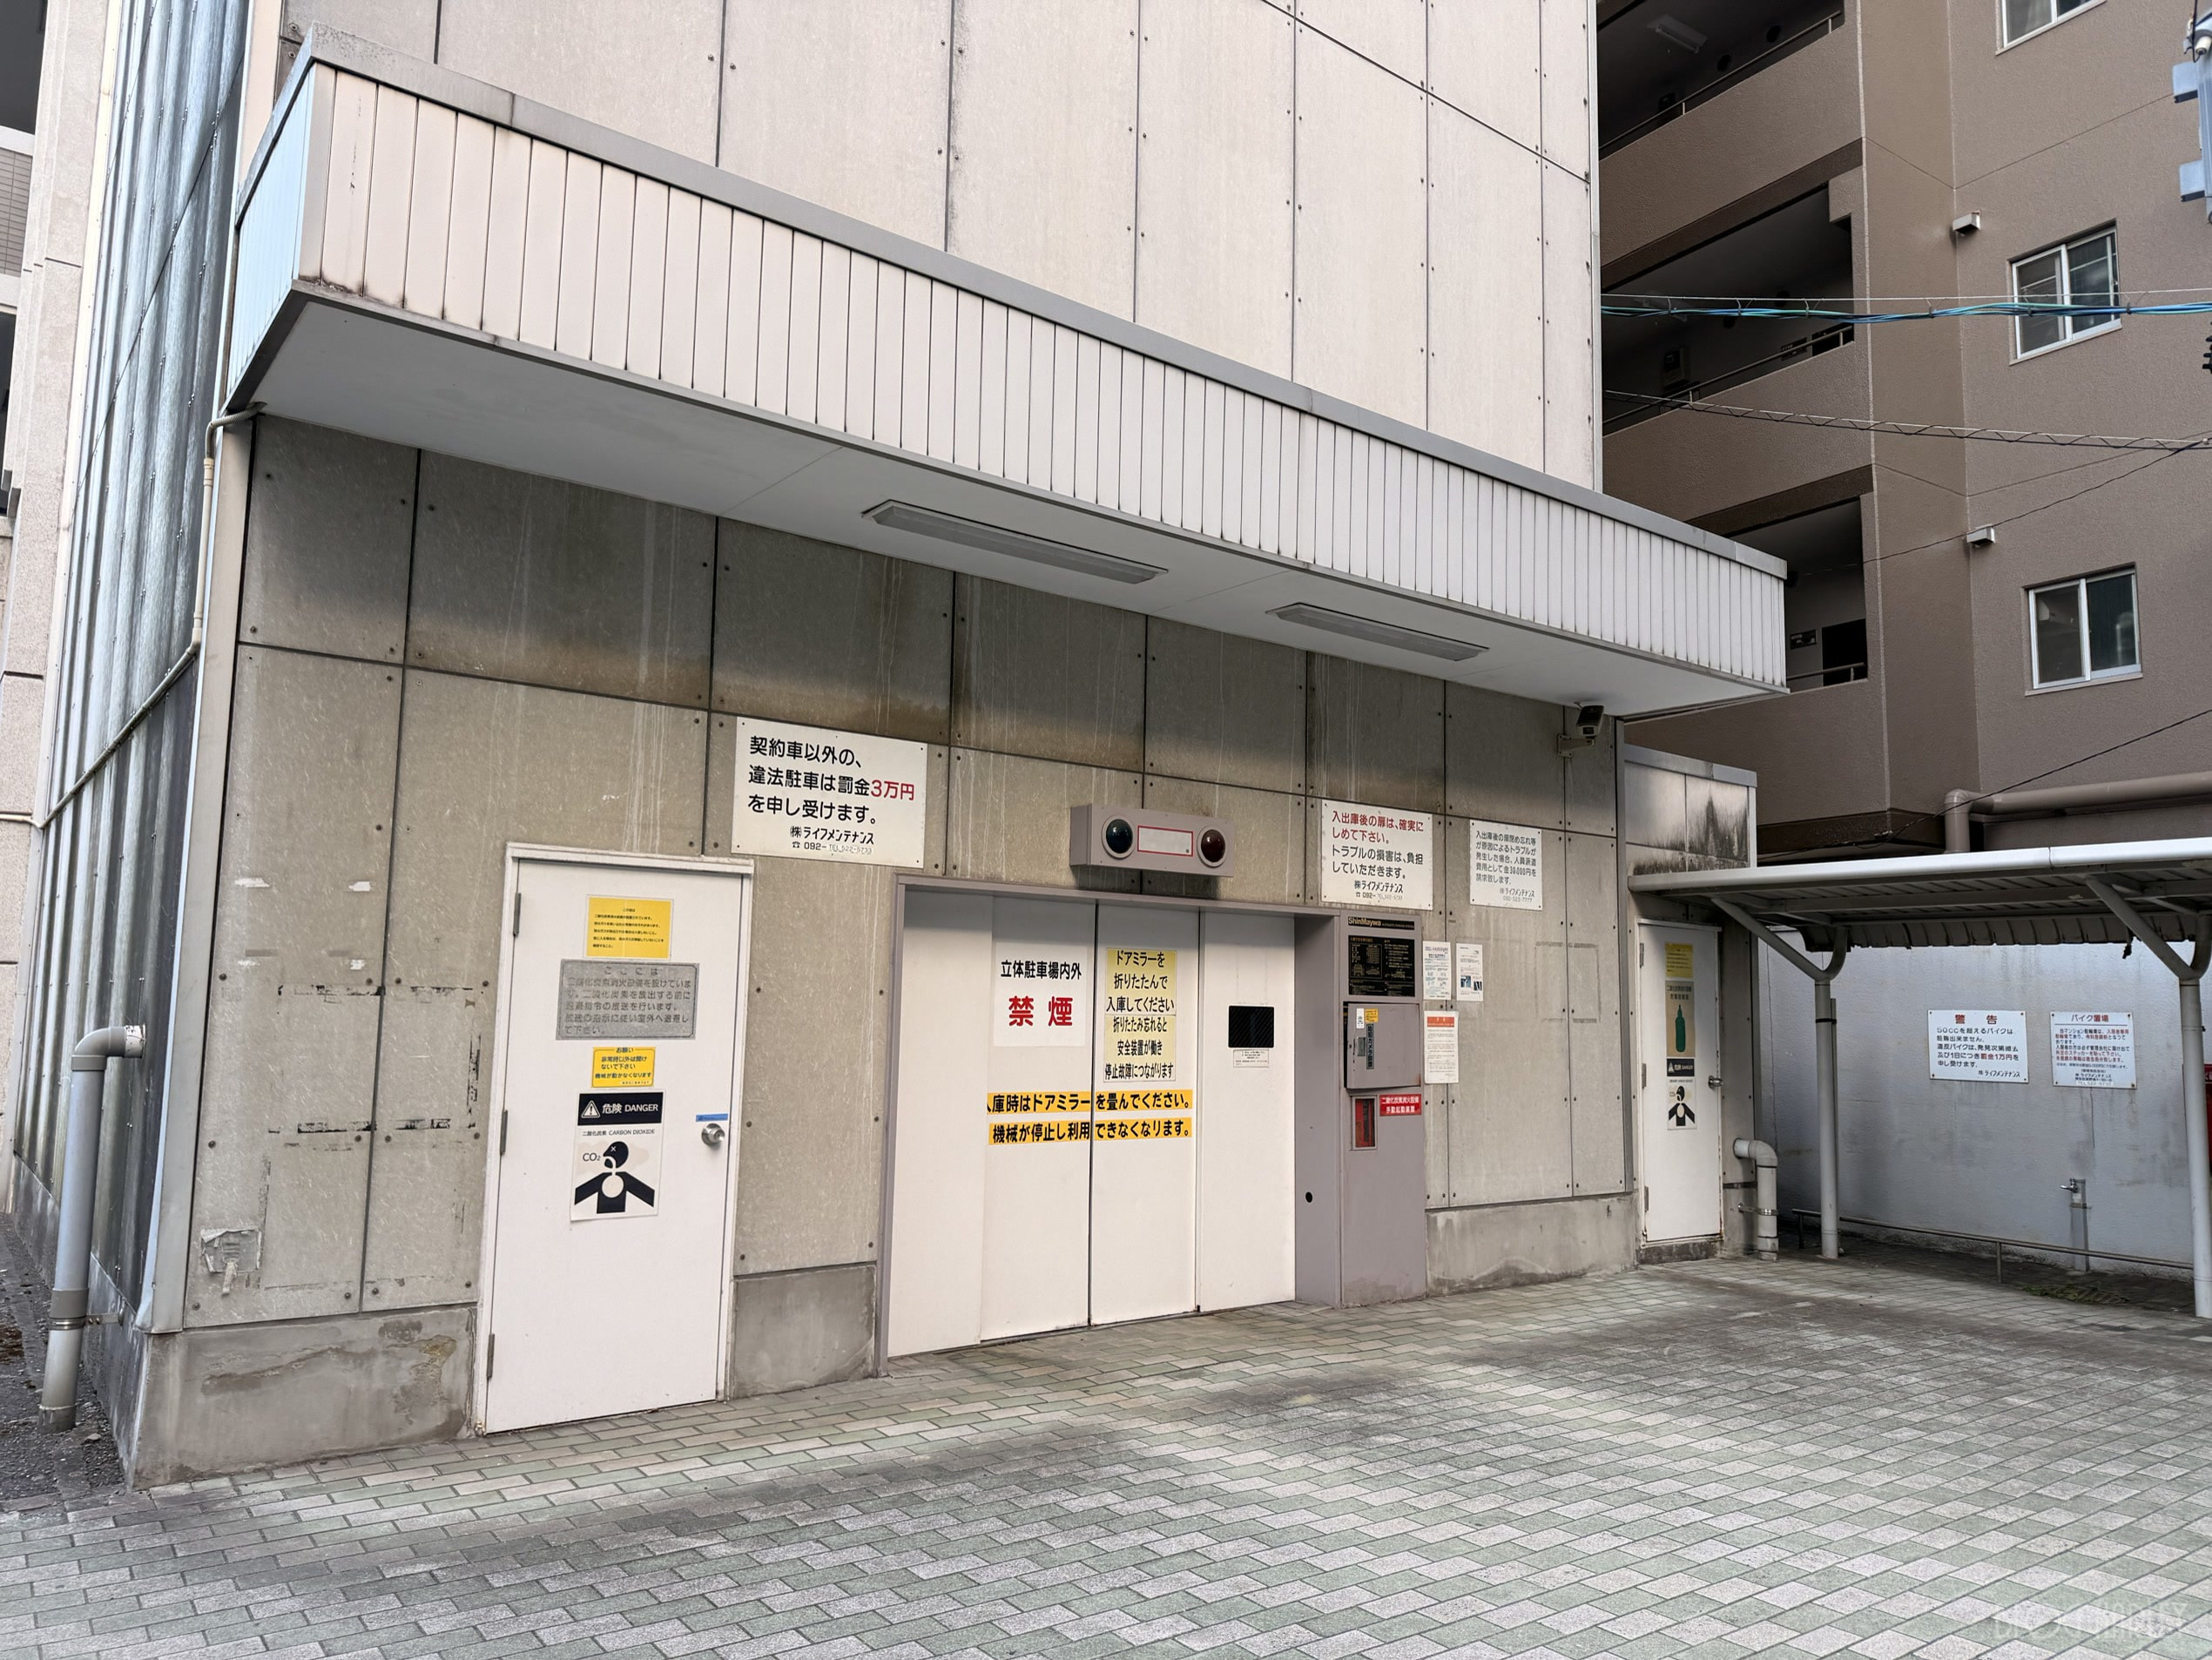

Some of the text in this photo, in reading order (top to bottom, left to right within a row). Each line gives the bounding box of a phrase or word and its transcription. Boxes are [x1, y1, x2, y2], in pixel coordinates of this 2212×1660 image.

[749, 735, 862, 768] 契約車以外の、
[748, 765, 915, 801] 違法駐車は罰金3万円
[747, 794, 876, 825] を申し受けます。
[1332, 810, 1424, 832] 入出庫後の扉は、確実に
[1332, 827, 1389, 844] しめて下さい。
[1332, 845, 1423, 865] トラブルの損害は、負担
[1332, 861, 1406, 879] していただきます。
[1116, 949, 1165, 968] ドアミラーを
[1001, 960, 1082, 980] 立体駐車場内外
[1114, 973, 1168, 989] 折りたたんで
[1106, 996, 1175, 1013] 入庫してください
[1113, 1016, 1168, 1033] 折りたたみ忘れると
[1117, 1039, 1163, 1056] 安全装置が働き
[1105, 1062, 1174, 1081] 停止故障につながります
[602, 1103, 658, 1114] 危険 DANGER
[993, 1119, 1189, 1144] 機械が停止し利用できなくなります。
